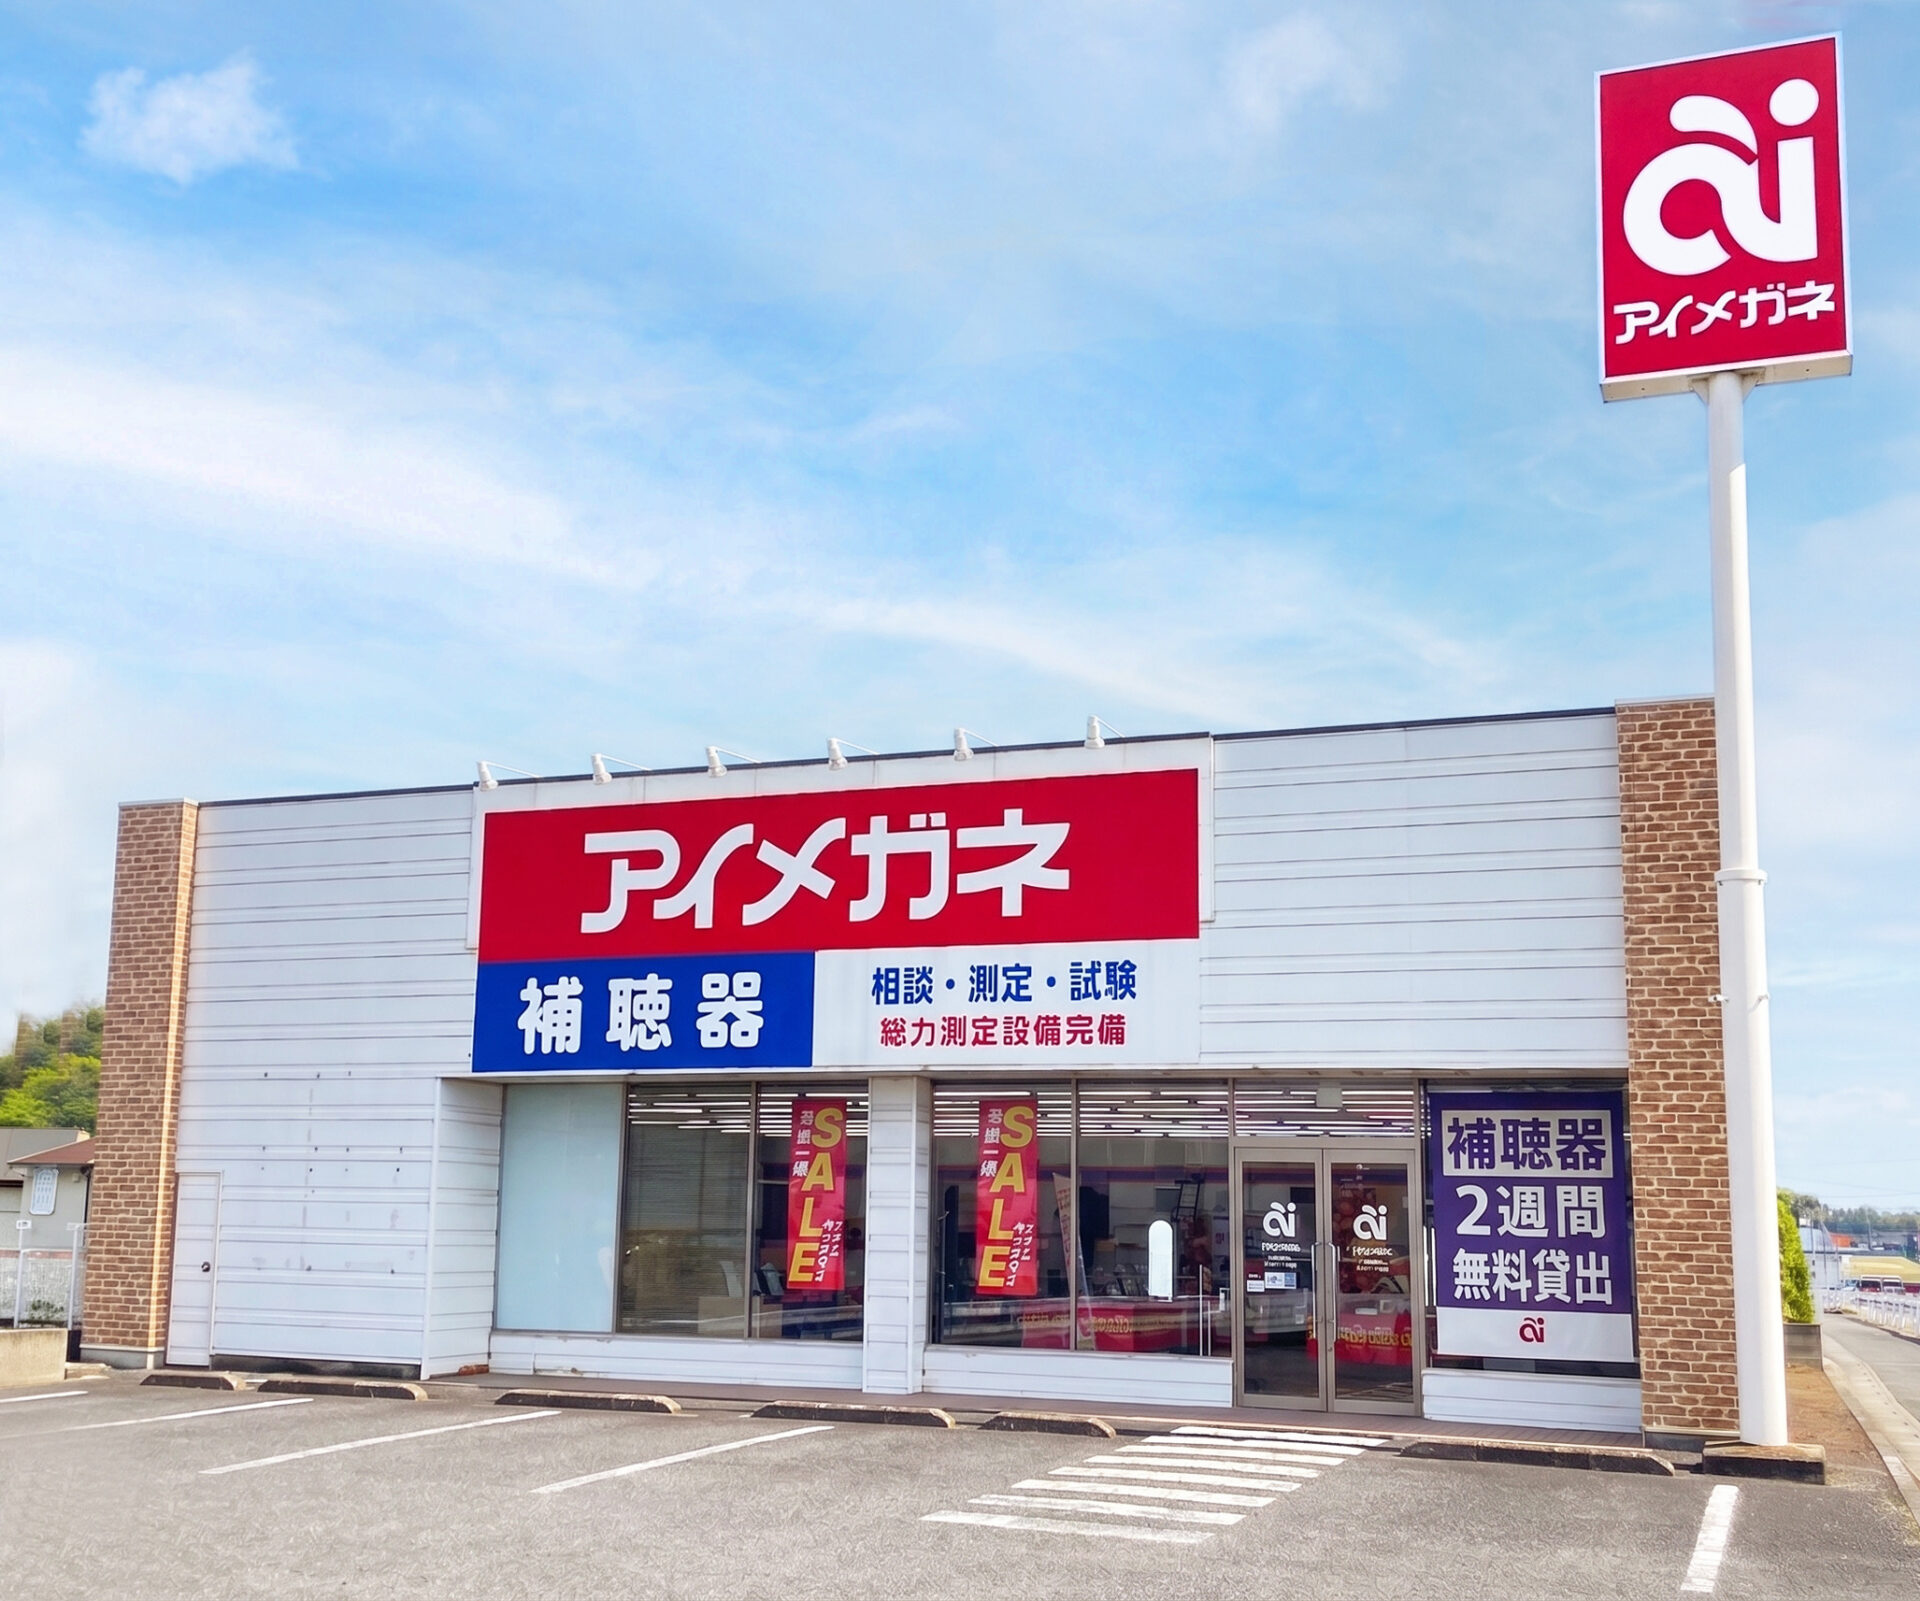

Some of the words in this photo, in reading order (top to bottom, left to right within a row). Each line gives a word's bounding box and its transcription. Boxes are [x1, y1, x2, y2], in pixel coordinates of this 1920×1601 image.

[1622, 78, 1819, 276] ai
[1613, 280, 1836, 344] アイメガネ
[580, 808, 1071, 935] アイメガネ
[517, 971, 765, 1055] 補聴器
[871, 959, 1137, 1005] 相談・測定・試験
[880, 1013, 1126, 1047] 総力測定設備完備
[1446, 1117, 1607, 1171] 補聴器
[788, 1107, 844, 1283] SALE
[978, 1105, 1035, 1287] SALE
[1455, 1185, 1606, 1239] 2週間
[1452, 1247, 1613, 1305] 無料貸出
